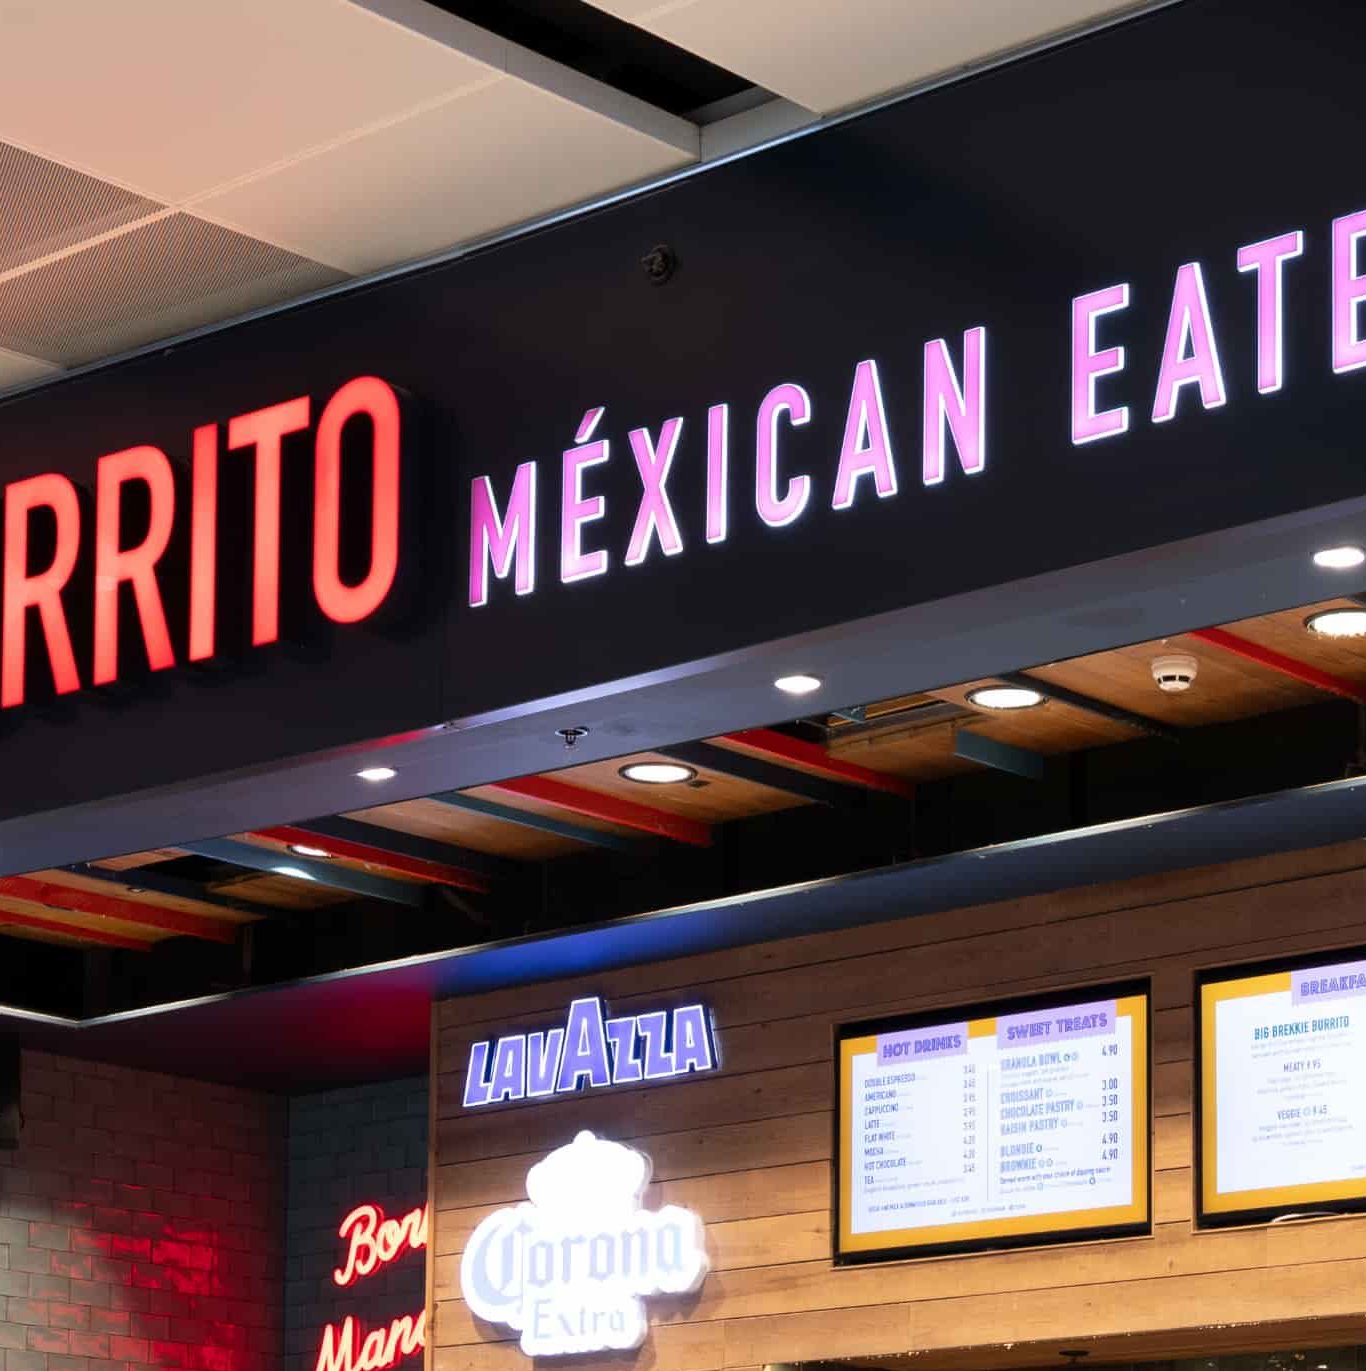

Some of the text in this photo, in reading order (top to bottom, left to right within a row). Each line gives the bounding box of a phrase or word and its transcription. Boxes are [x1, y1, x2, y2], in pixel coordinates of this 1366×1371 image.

[1007, 1012, 1108, 1041] SWEET TREATS
[1254, 1015, 1349, 1040] BIG BREKKIE BURRITO
[463, 997, 713, 1107] LAVAZZA
[883, 1034, 962, 1059] HOT DRINKS
[1039, 1051, 1061, 1067] BOWL
[1102, 1044, 1118, 1057] 4.90
[1002, 1087, 1044, 1104] CROISSANT
[1002, 1103, 1044, 1120] CHOCOLATE
[1046, 1099, 1075, 1114] PASTRY
[865, 1119, 880, 1130] LATTE
[1029, 1118, 1059, 1133] PASTRY
[865, 1133, 877, 1143] FLAT
[1102, 1132, 1118, 1145] 4.90
[1002, 1148, 1118, 1174] BROWNIE 4.90
[865, 1175, 875, 1186] TEA
[472, 1219, 683, 1307] Corona
[533, 1297, 626, 1340] Extra
